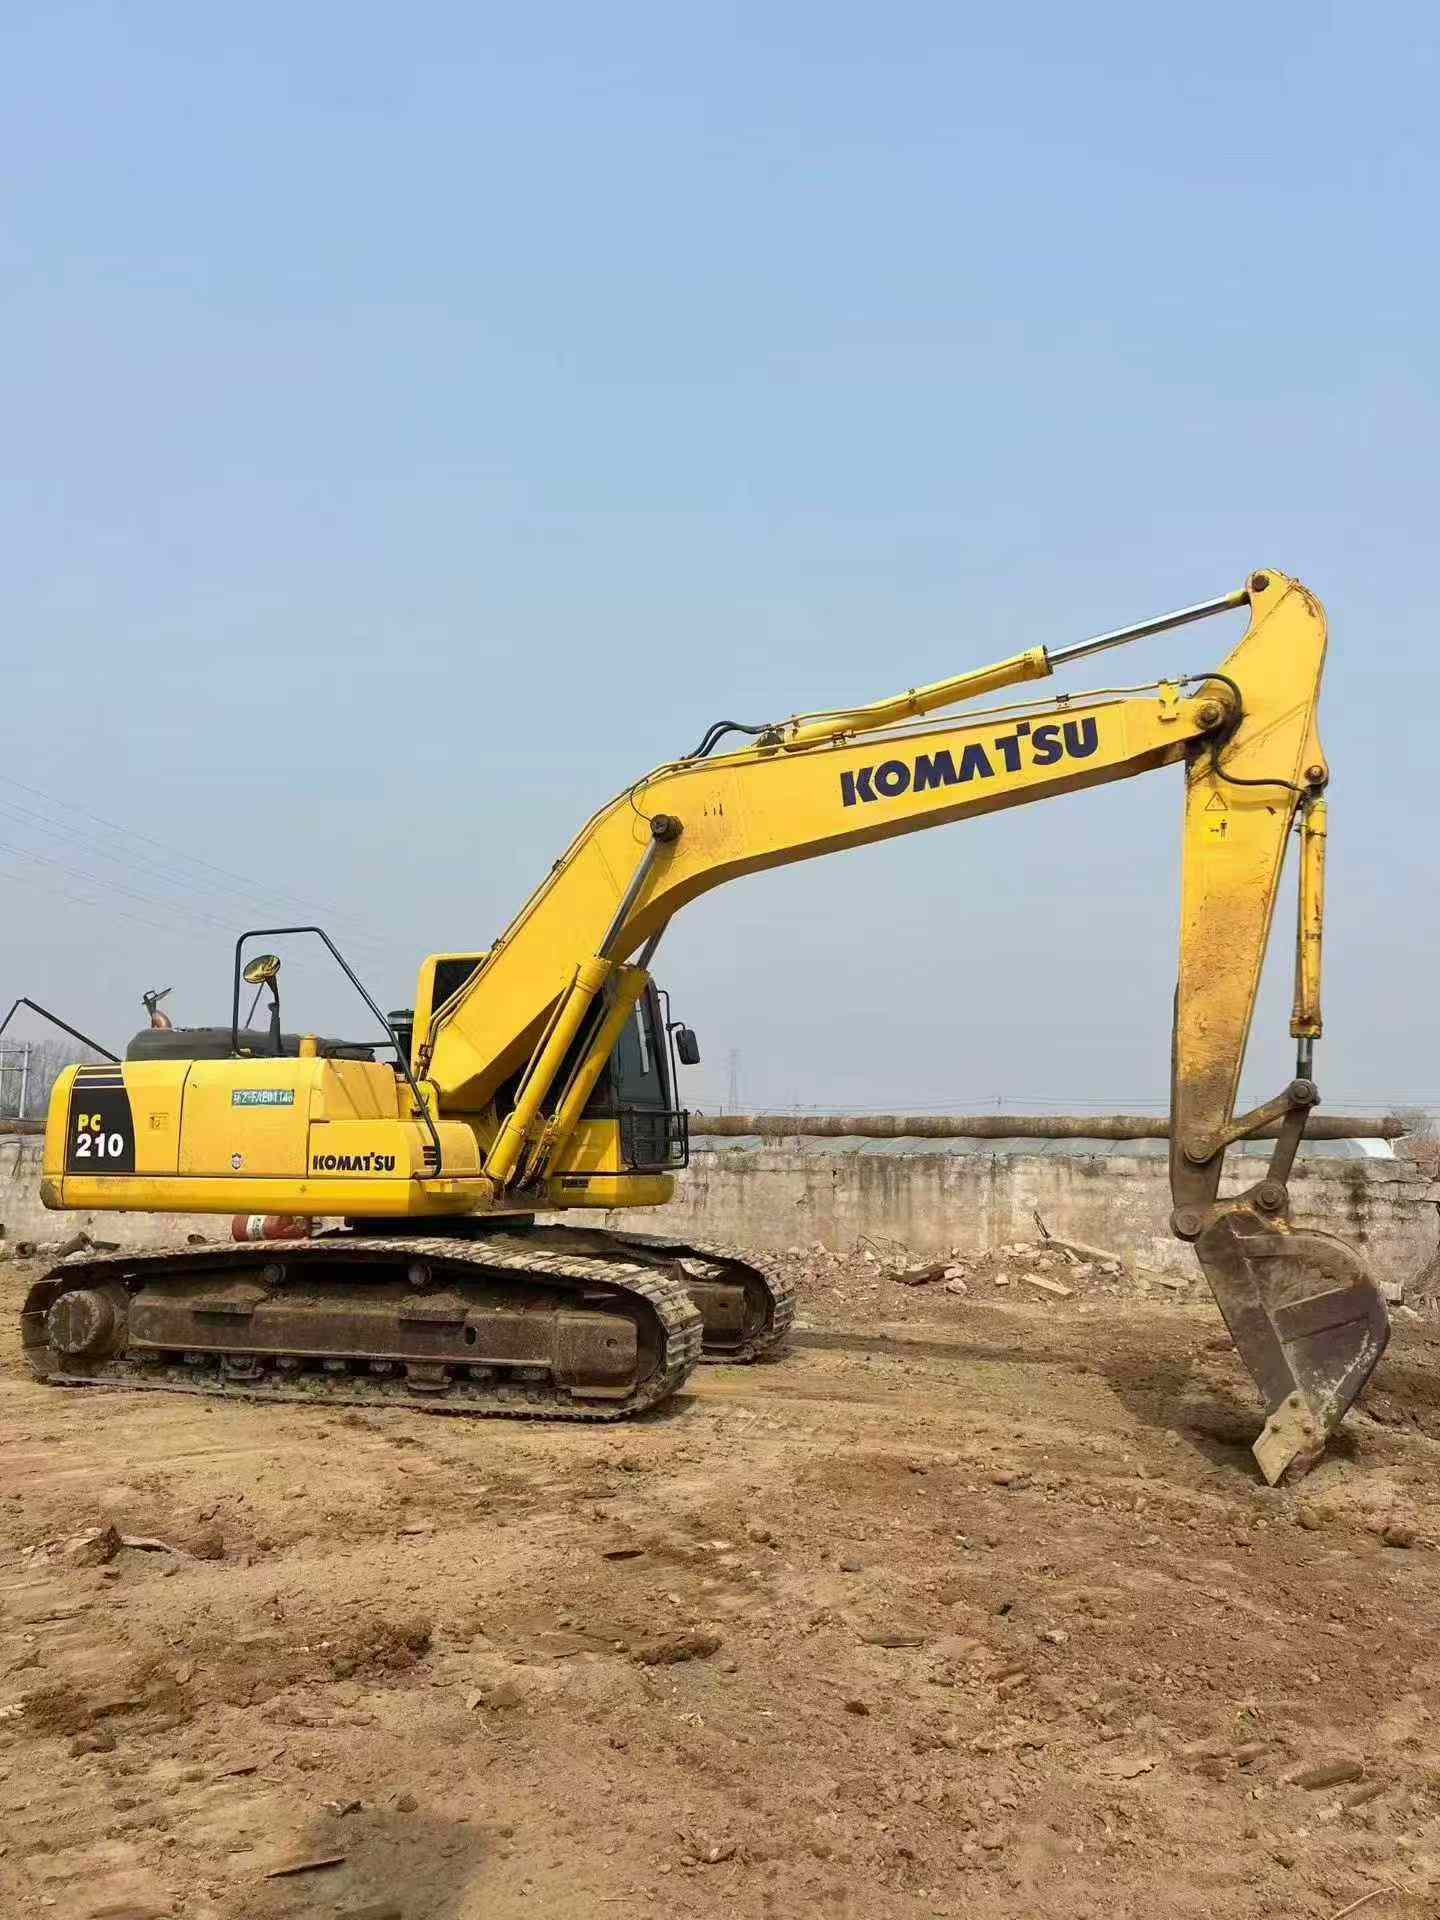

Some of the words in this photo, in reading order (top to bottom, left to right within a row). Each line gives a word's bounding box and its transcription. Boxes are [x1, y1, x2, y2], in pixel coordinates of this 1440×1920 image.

[840, 717, 1099, 807] KOMATSU
[78, 1113, 102, 1132] PC
[75, 1133, 124, 1158] 210
[312, 1151, 395, 1171] KOMATSU
